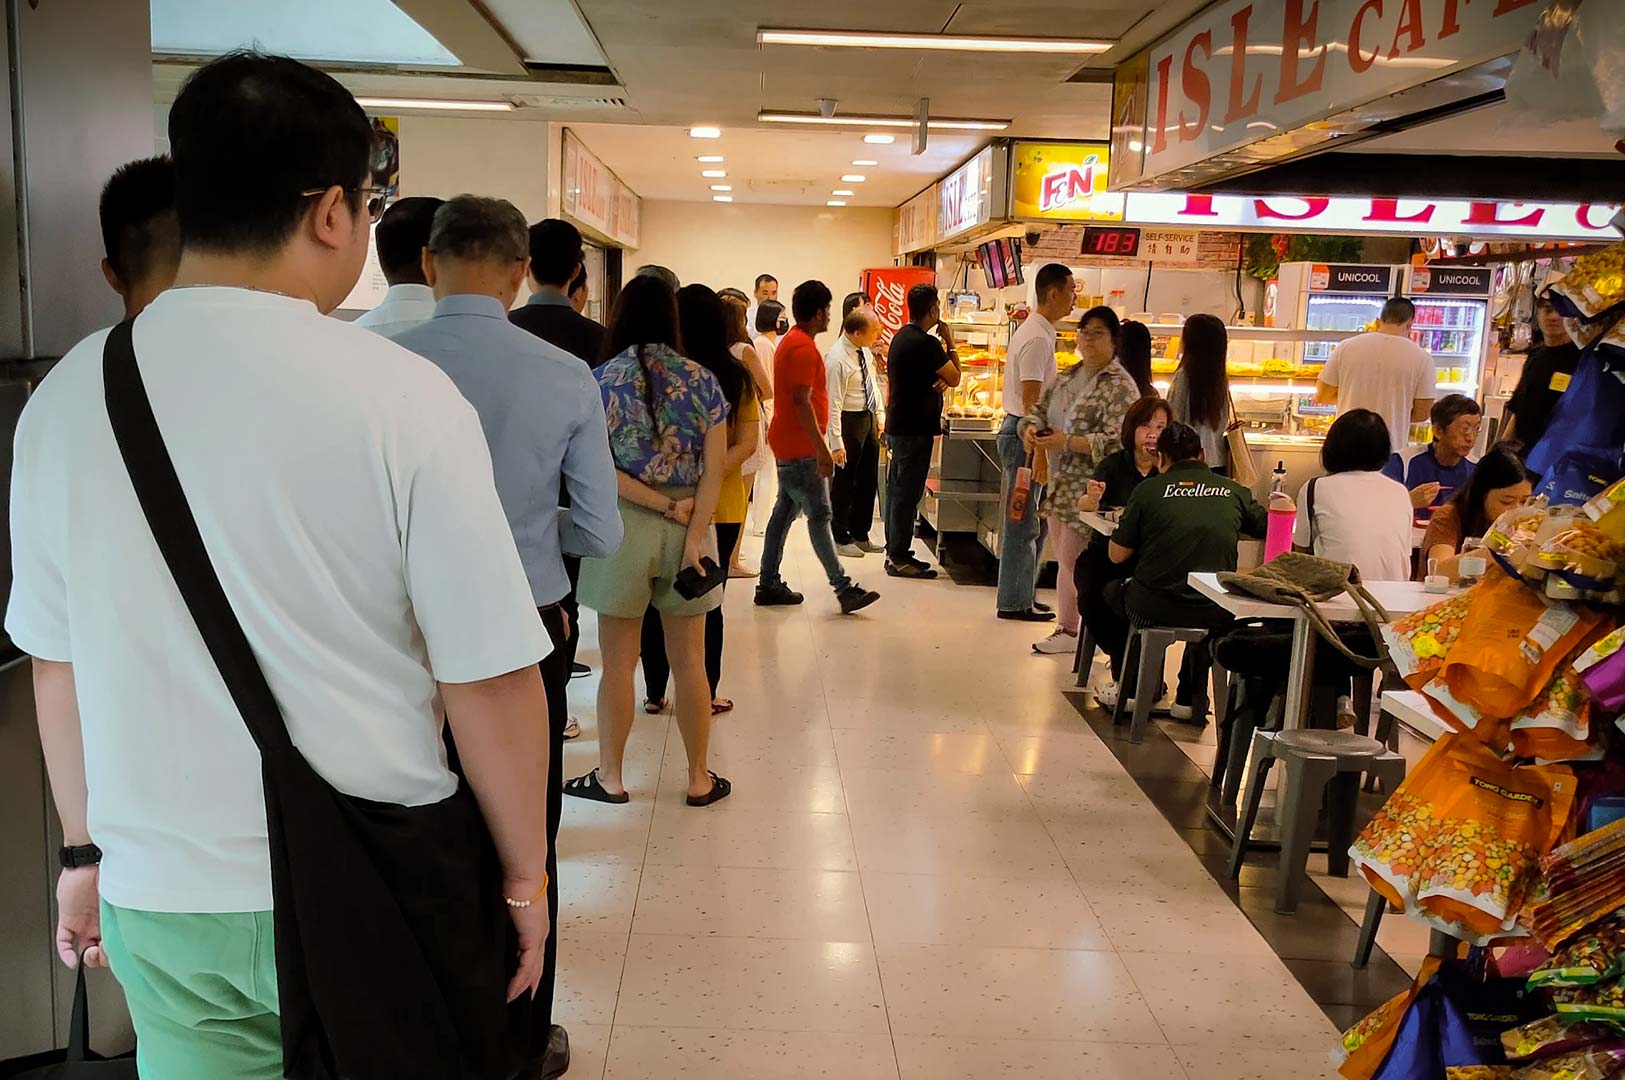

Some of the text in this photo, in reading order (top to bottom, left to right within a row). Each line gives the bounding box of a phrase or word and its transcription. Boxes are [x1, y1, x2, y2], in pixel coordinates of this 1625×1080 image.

[1152, 0, 1327, 155] ISLE
[1096, 232, 1136, 253] 183
[1145, 232, 1194, 243] SELF-SERVICE
[1338, 272, 1381, 283] UNICOOL
[1439, 275, 1481, 286] UNICOOL
[1163, 483, 1231, 498] Eccellente
